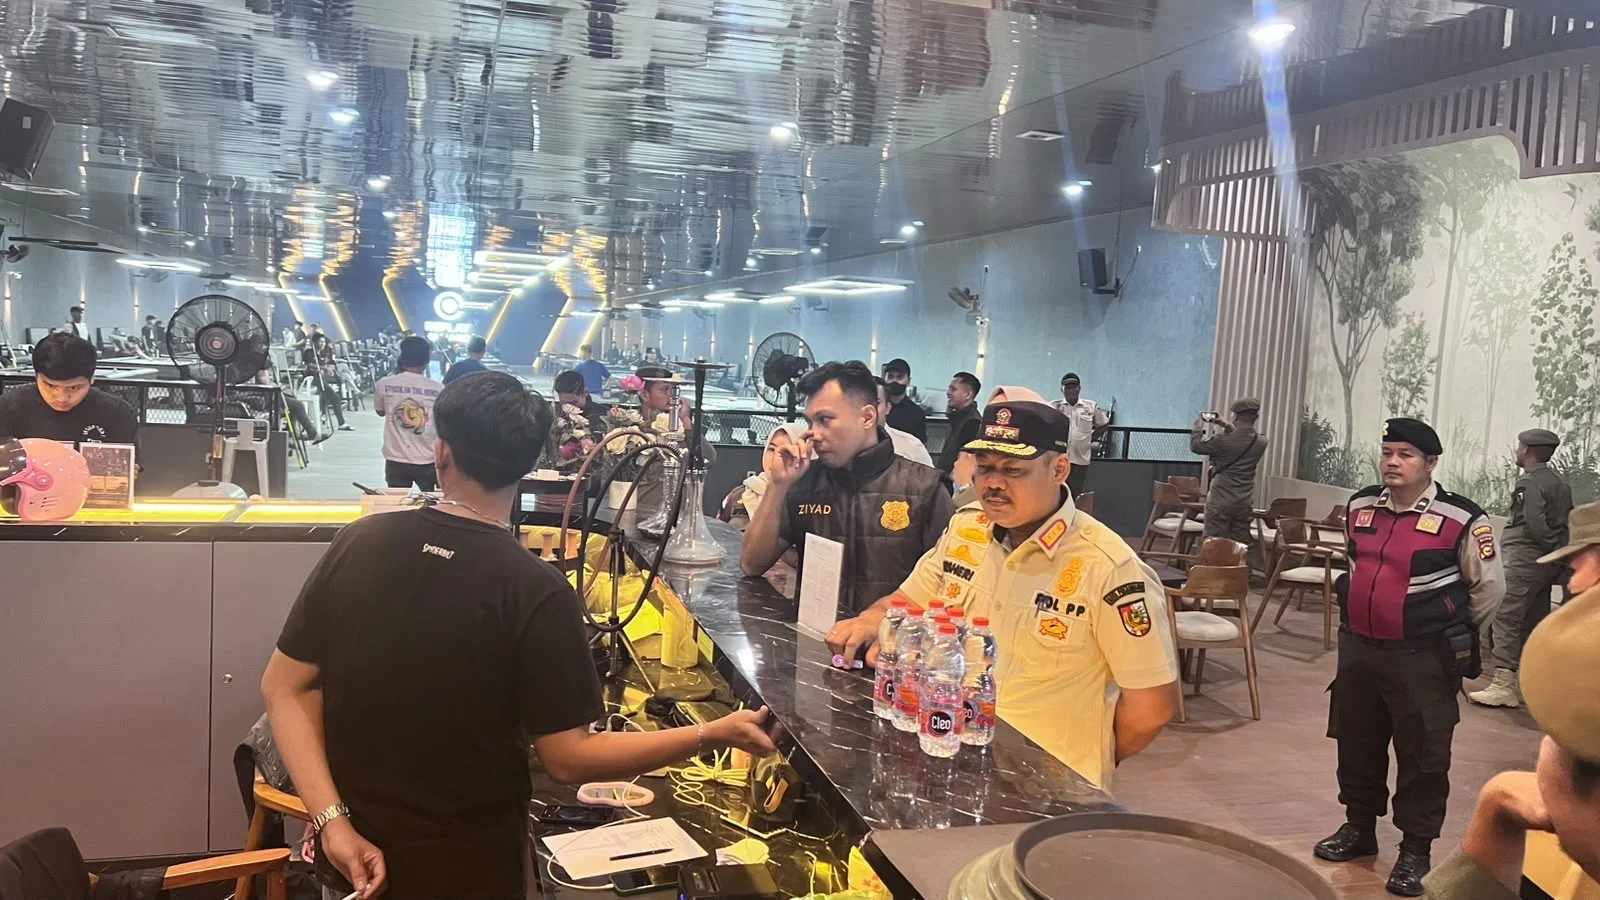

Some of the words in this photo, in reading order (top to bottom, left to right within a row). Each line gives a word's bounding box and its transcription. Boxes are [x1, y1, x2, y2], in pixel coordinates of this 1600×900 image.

[798, 504, 832, 515] ZIYAD
[1065, 602, 1086, 617] PP
[931, 715, 951, 730] Cleo
